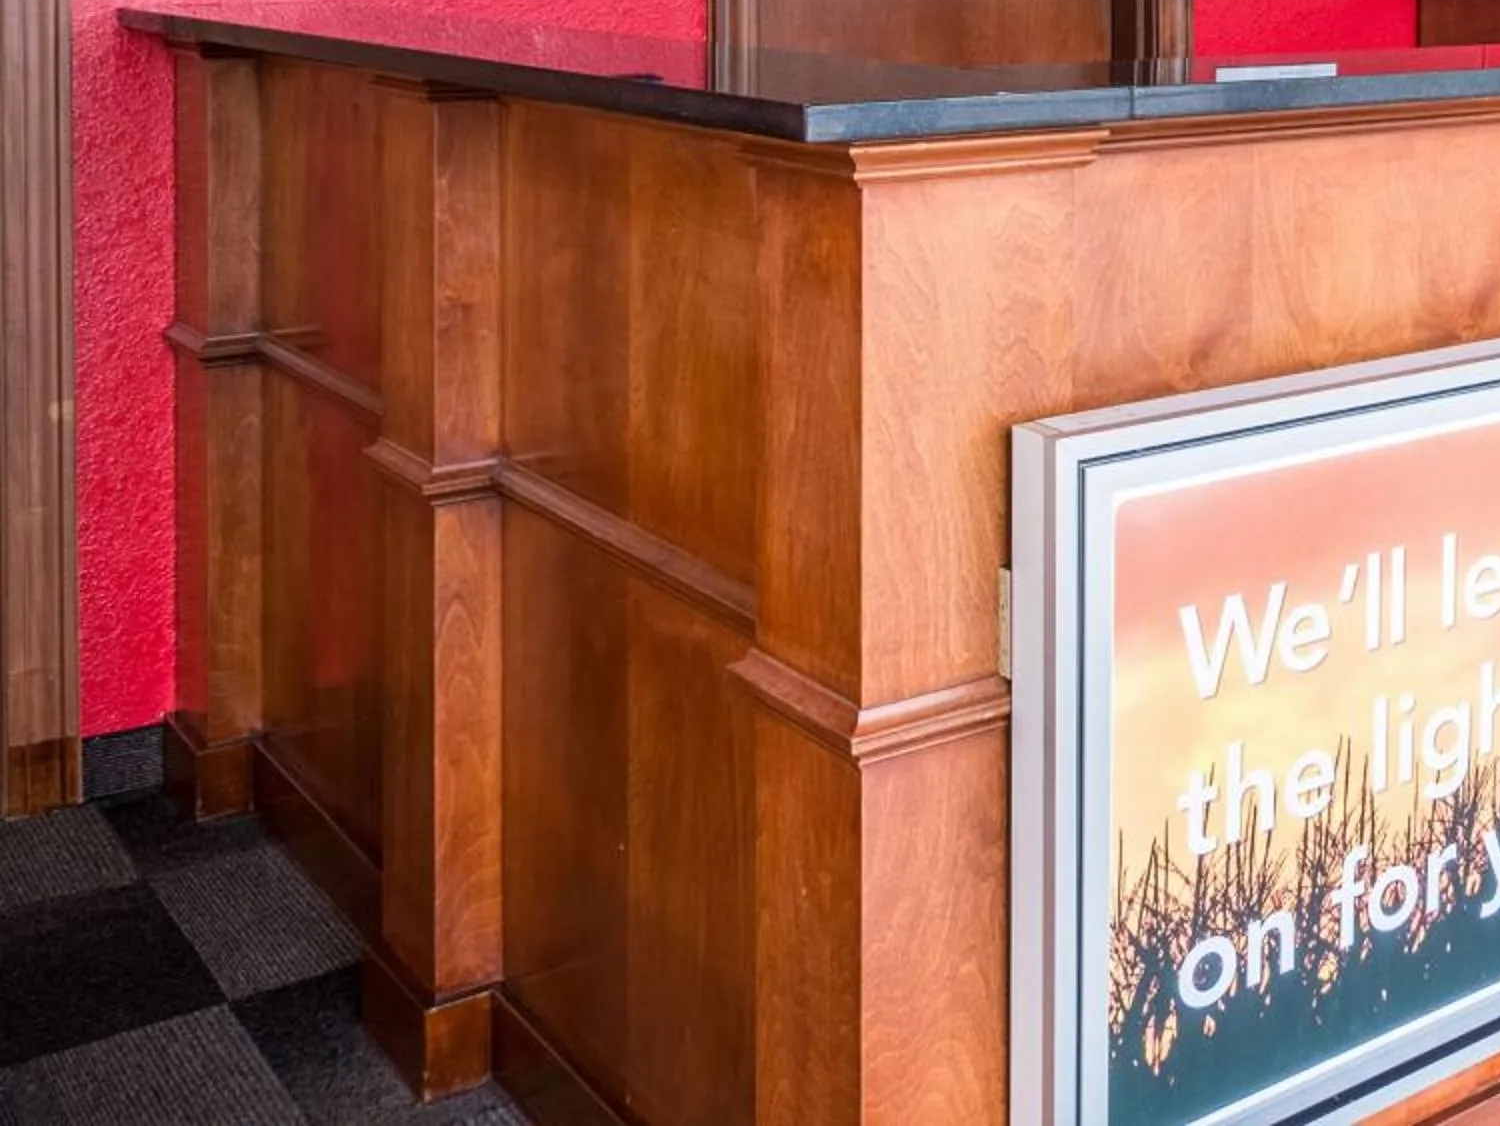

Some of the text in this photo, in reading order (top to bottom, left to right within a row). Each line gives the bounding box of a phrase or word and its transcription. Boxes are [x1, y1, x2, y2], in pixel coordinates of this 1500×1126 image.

[1179, 545, 1407, 701] We'll
[1176, 740, 1338, 856] the
[1176, 911, 1296, 1011] on
[1331, 838, 1463, 951] for
